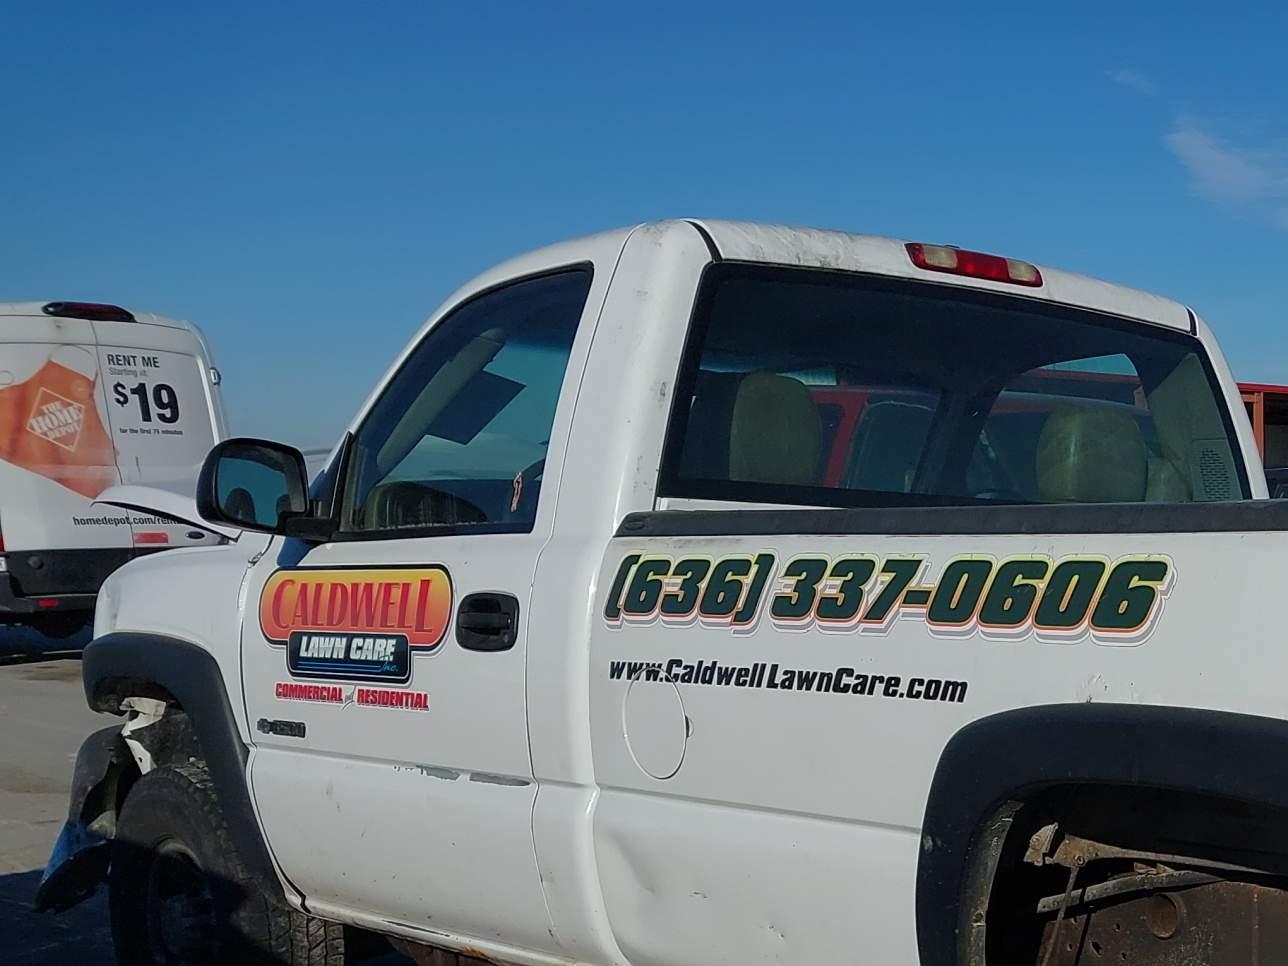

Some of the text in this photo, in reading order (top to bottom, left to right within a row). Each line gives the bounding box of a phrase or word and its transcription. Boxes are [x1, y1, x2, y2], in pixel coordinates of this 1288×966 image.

[107, 354, 160, 368] RENT ME
[113, 381, 180, 424] $19
[272, 579, 433, 633] CALDWELL
[604, 552, 1174, 640] (636) 337-0606
[299, 636, 398, 662] LAWN CARE
[275, 682, 345, 703] COMMERCIAL
[356, 687, 430, 710] RESIDENTIAL
[608, 656, 969, 704] www.CaldwellLawnCare.com
